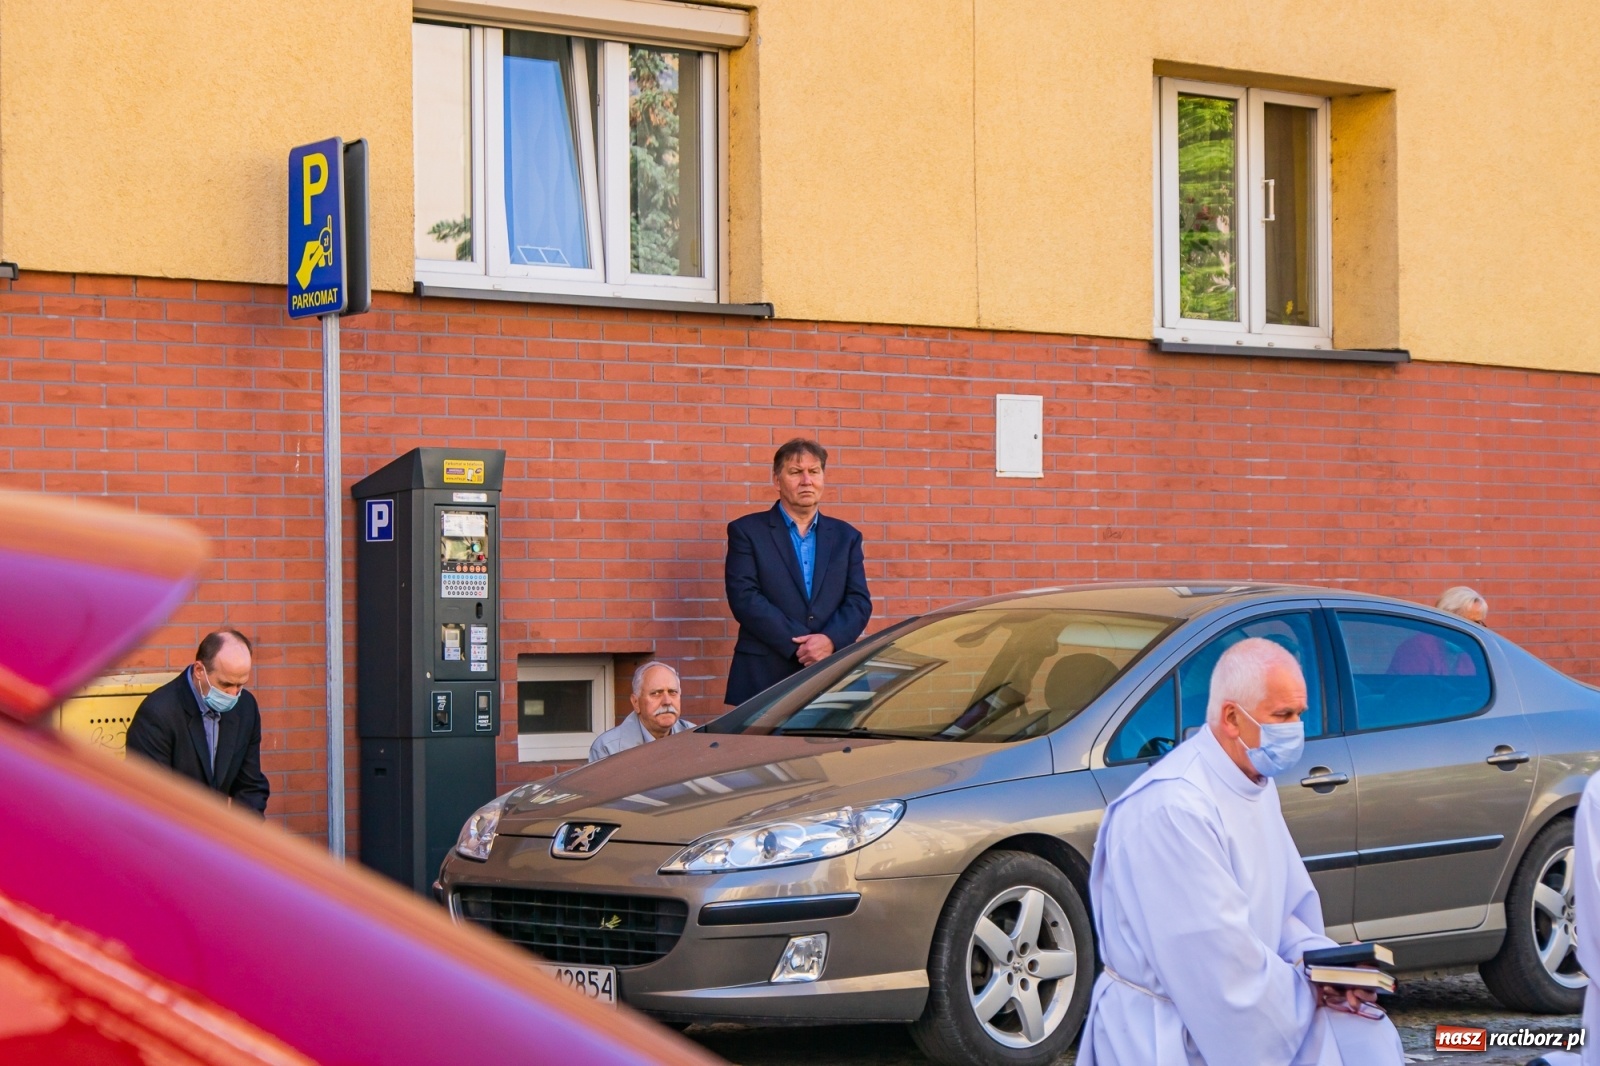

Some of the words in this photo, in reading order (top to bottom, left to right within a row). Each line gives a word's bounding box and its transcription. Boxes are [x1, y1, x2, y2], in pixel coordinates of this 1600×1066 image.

[303, 153, 329, 226] P
[292, 287, 339, 310] PARKOMAT
[372, 504, 389, 538] P
